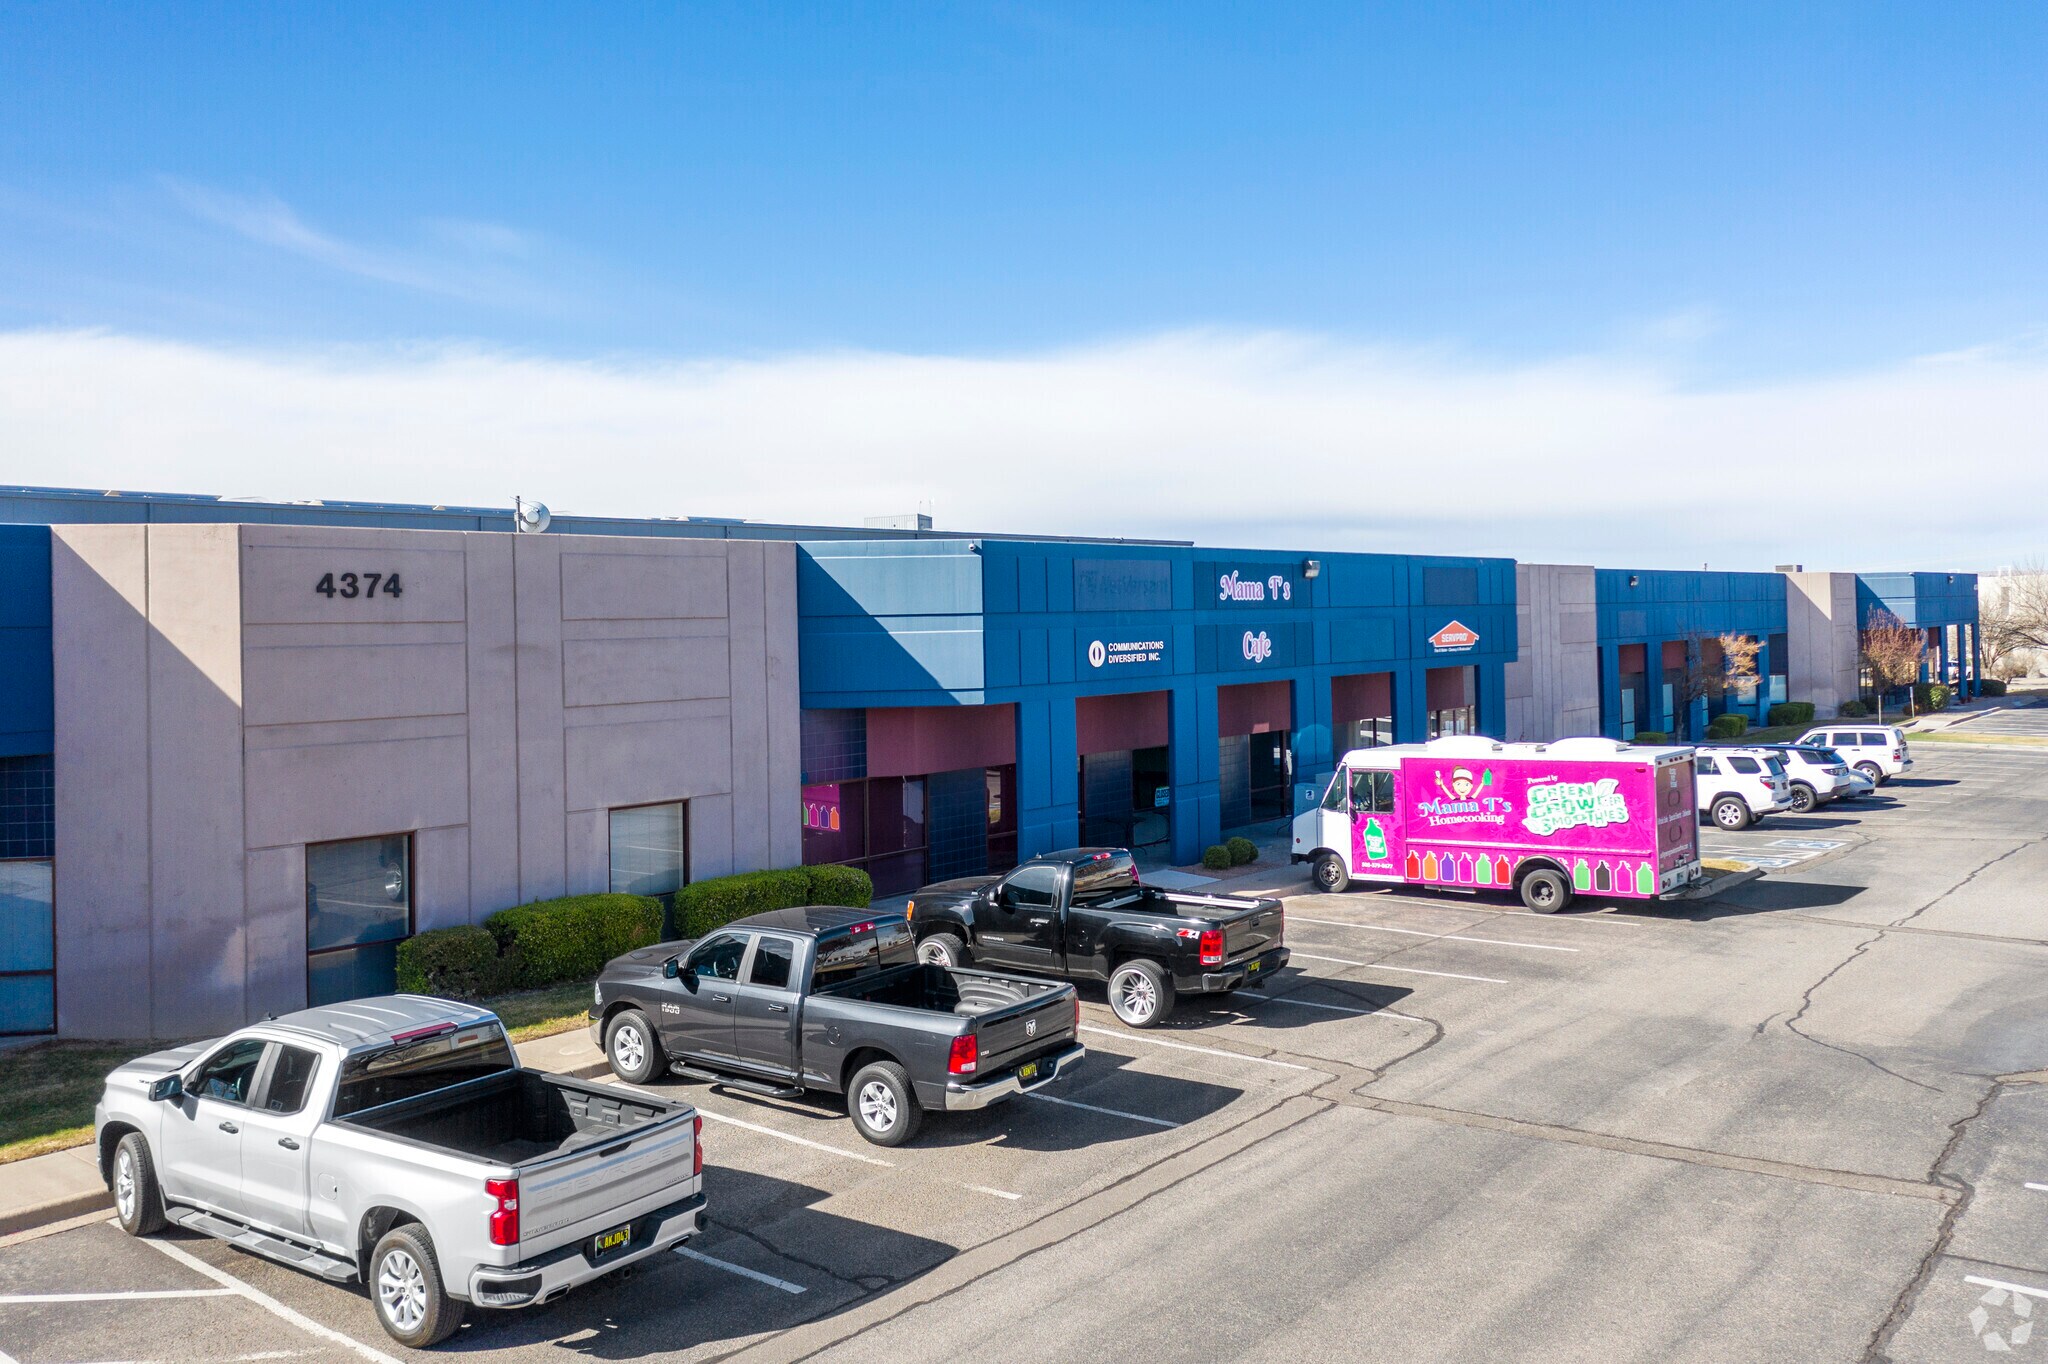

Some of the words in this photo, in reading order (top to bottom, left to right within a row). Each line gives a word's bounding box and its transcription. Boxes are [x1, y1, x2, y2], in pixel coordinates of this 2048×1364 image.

[316, 572, 403, 599] 4374
[1220, 570, 1265, 601] Mama
[1268, 575, 1291, 600] T's
[1108, 640, 1164, 652] COMMUNICATIONS
[1243, 631, 1272, 663] Cafe
[1108, 653, 1147, 664] DIVERSIFIED
[1148, 652, 1161, 661] INC.
[1418, 797, 1479, 817] Mama
[1482, 797, 1512, 812] T's
[1428, 812, 1505, 826] Homecooking
[1541, 807, 1626, 833] SMOOTHIES
